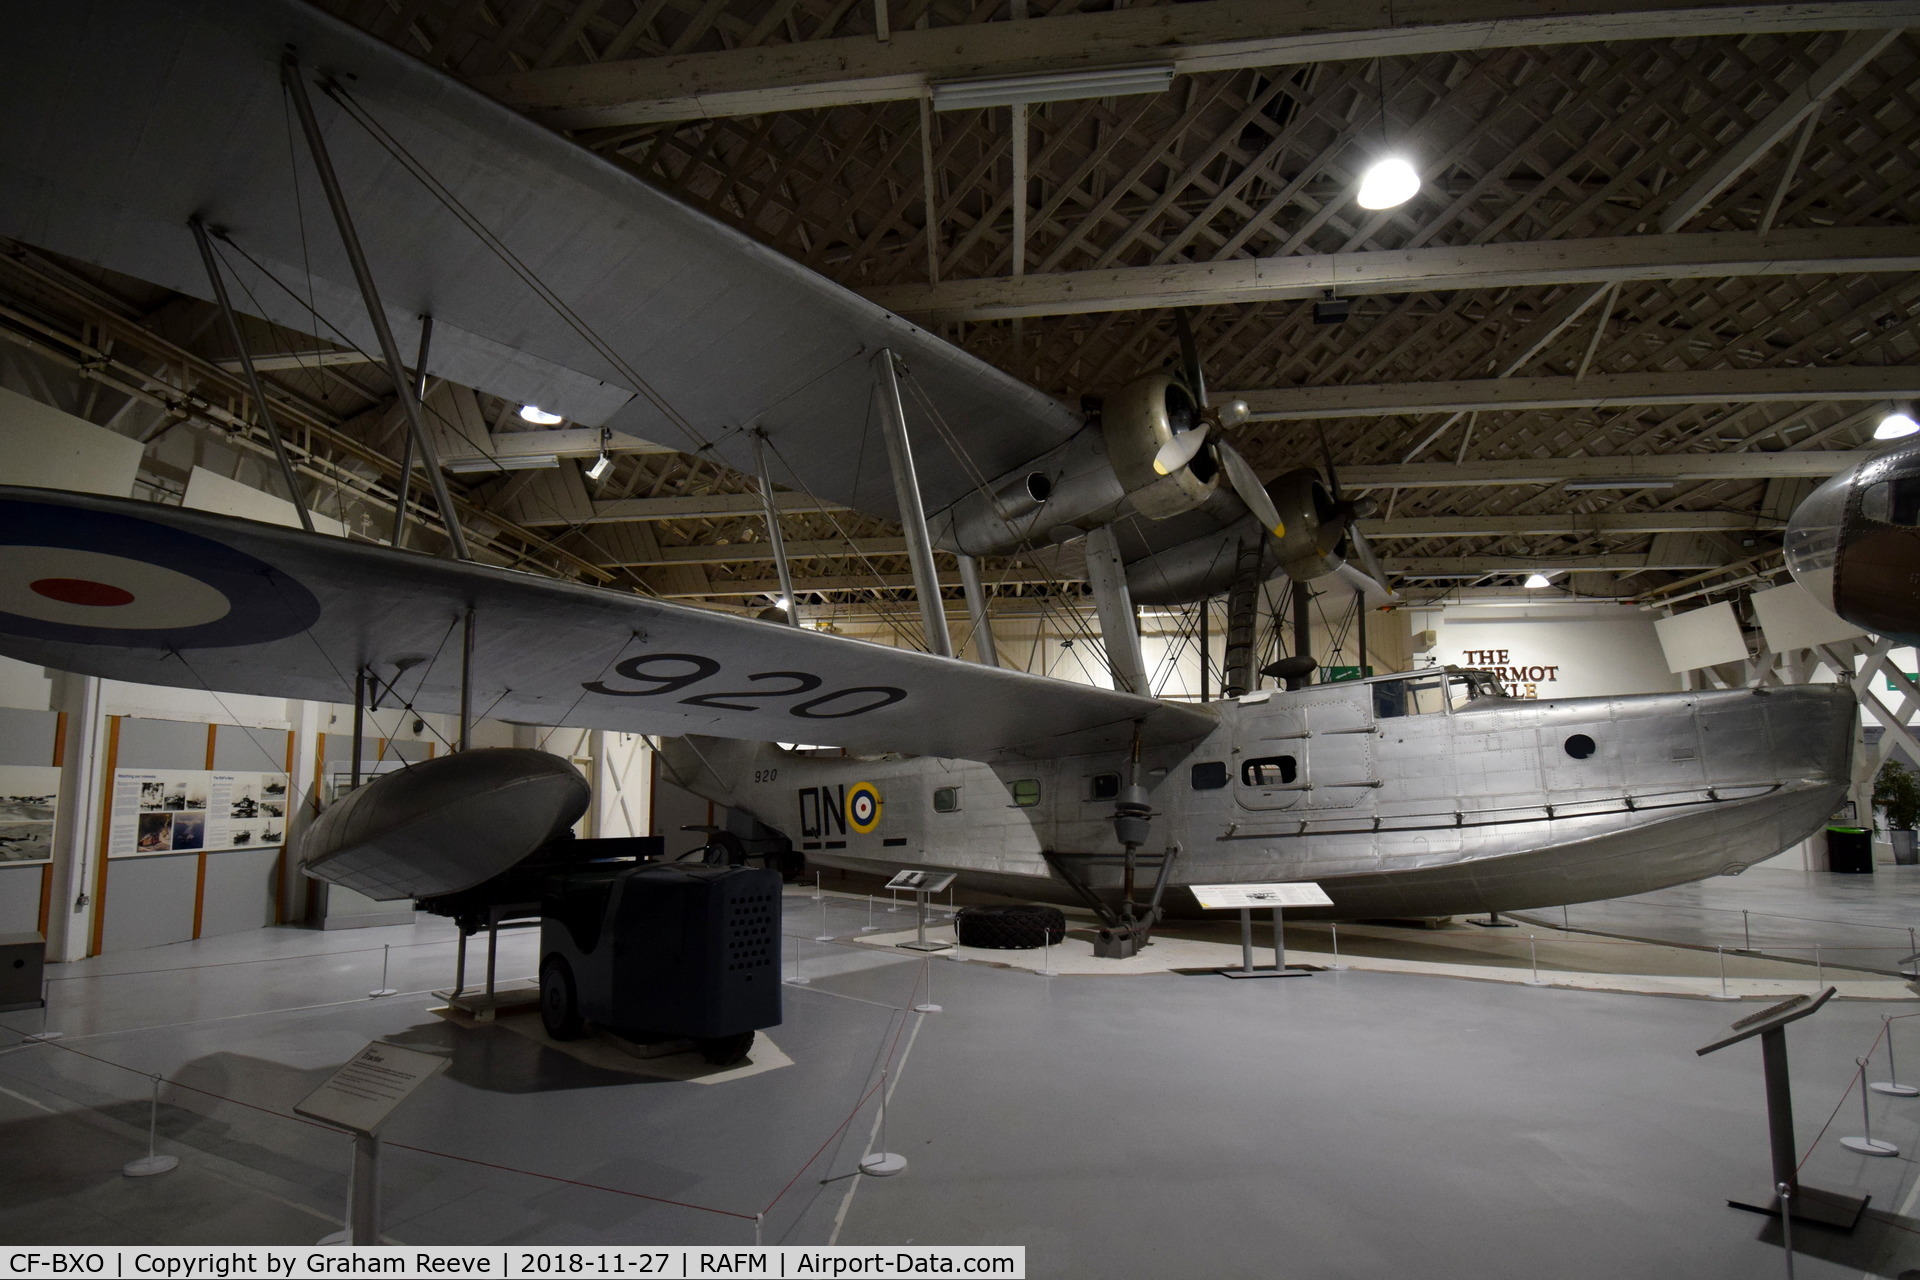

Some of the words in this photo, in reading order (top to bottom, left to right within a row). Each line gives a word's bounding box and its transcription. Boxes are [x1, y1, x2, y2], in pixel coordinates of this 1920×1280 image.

[1463, 649, 1510, 665] THE
[1465, 666, 1559, 681] RMOT
[581, 653, 908, 719] 920
[754, 768, 778, 783] 920
[798, 784, 847, 838] QN
